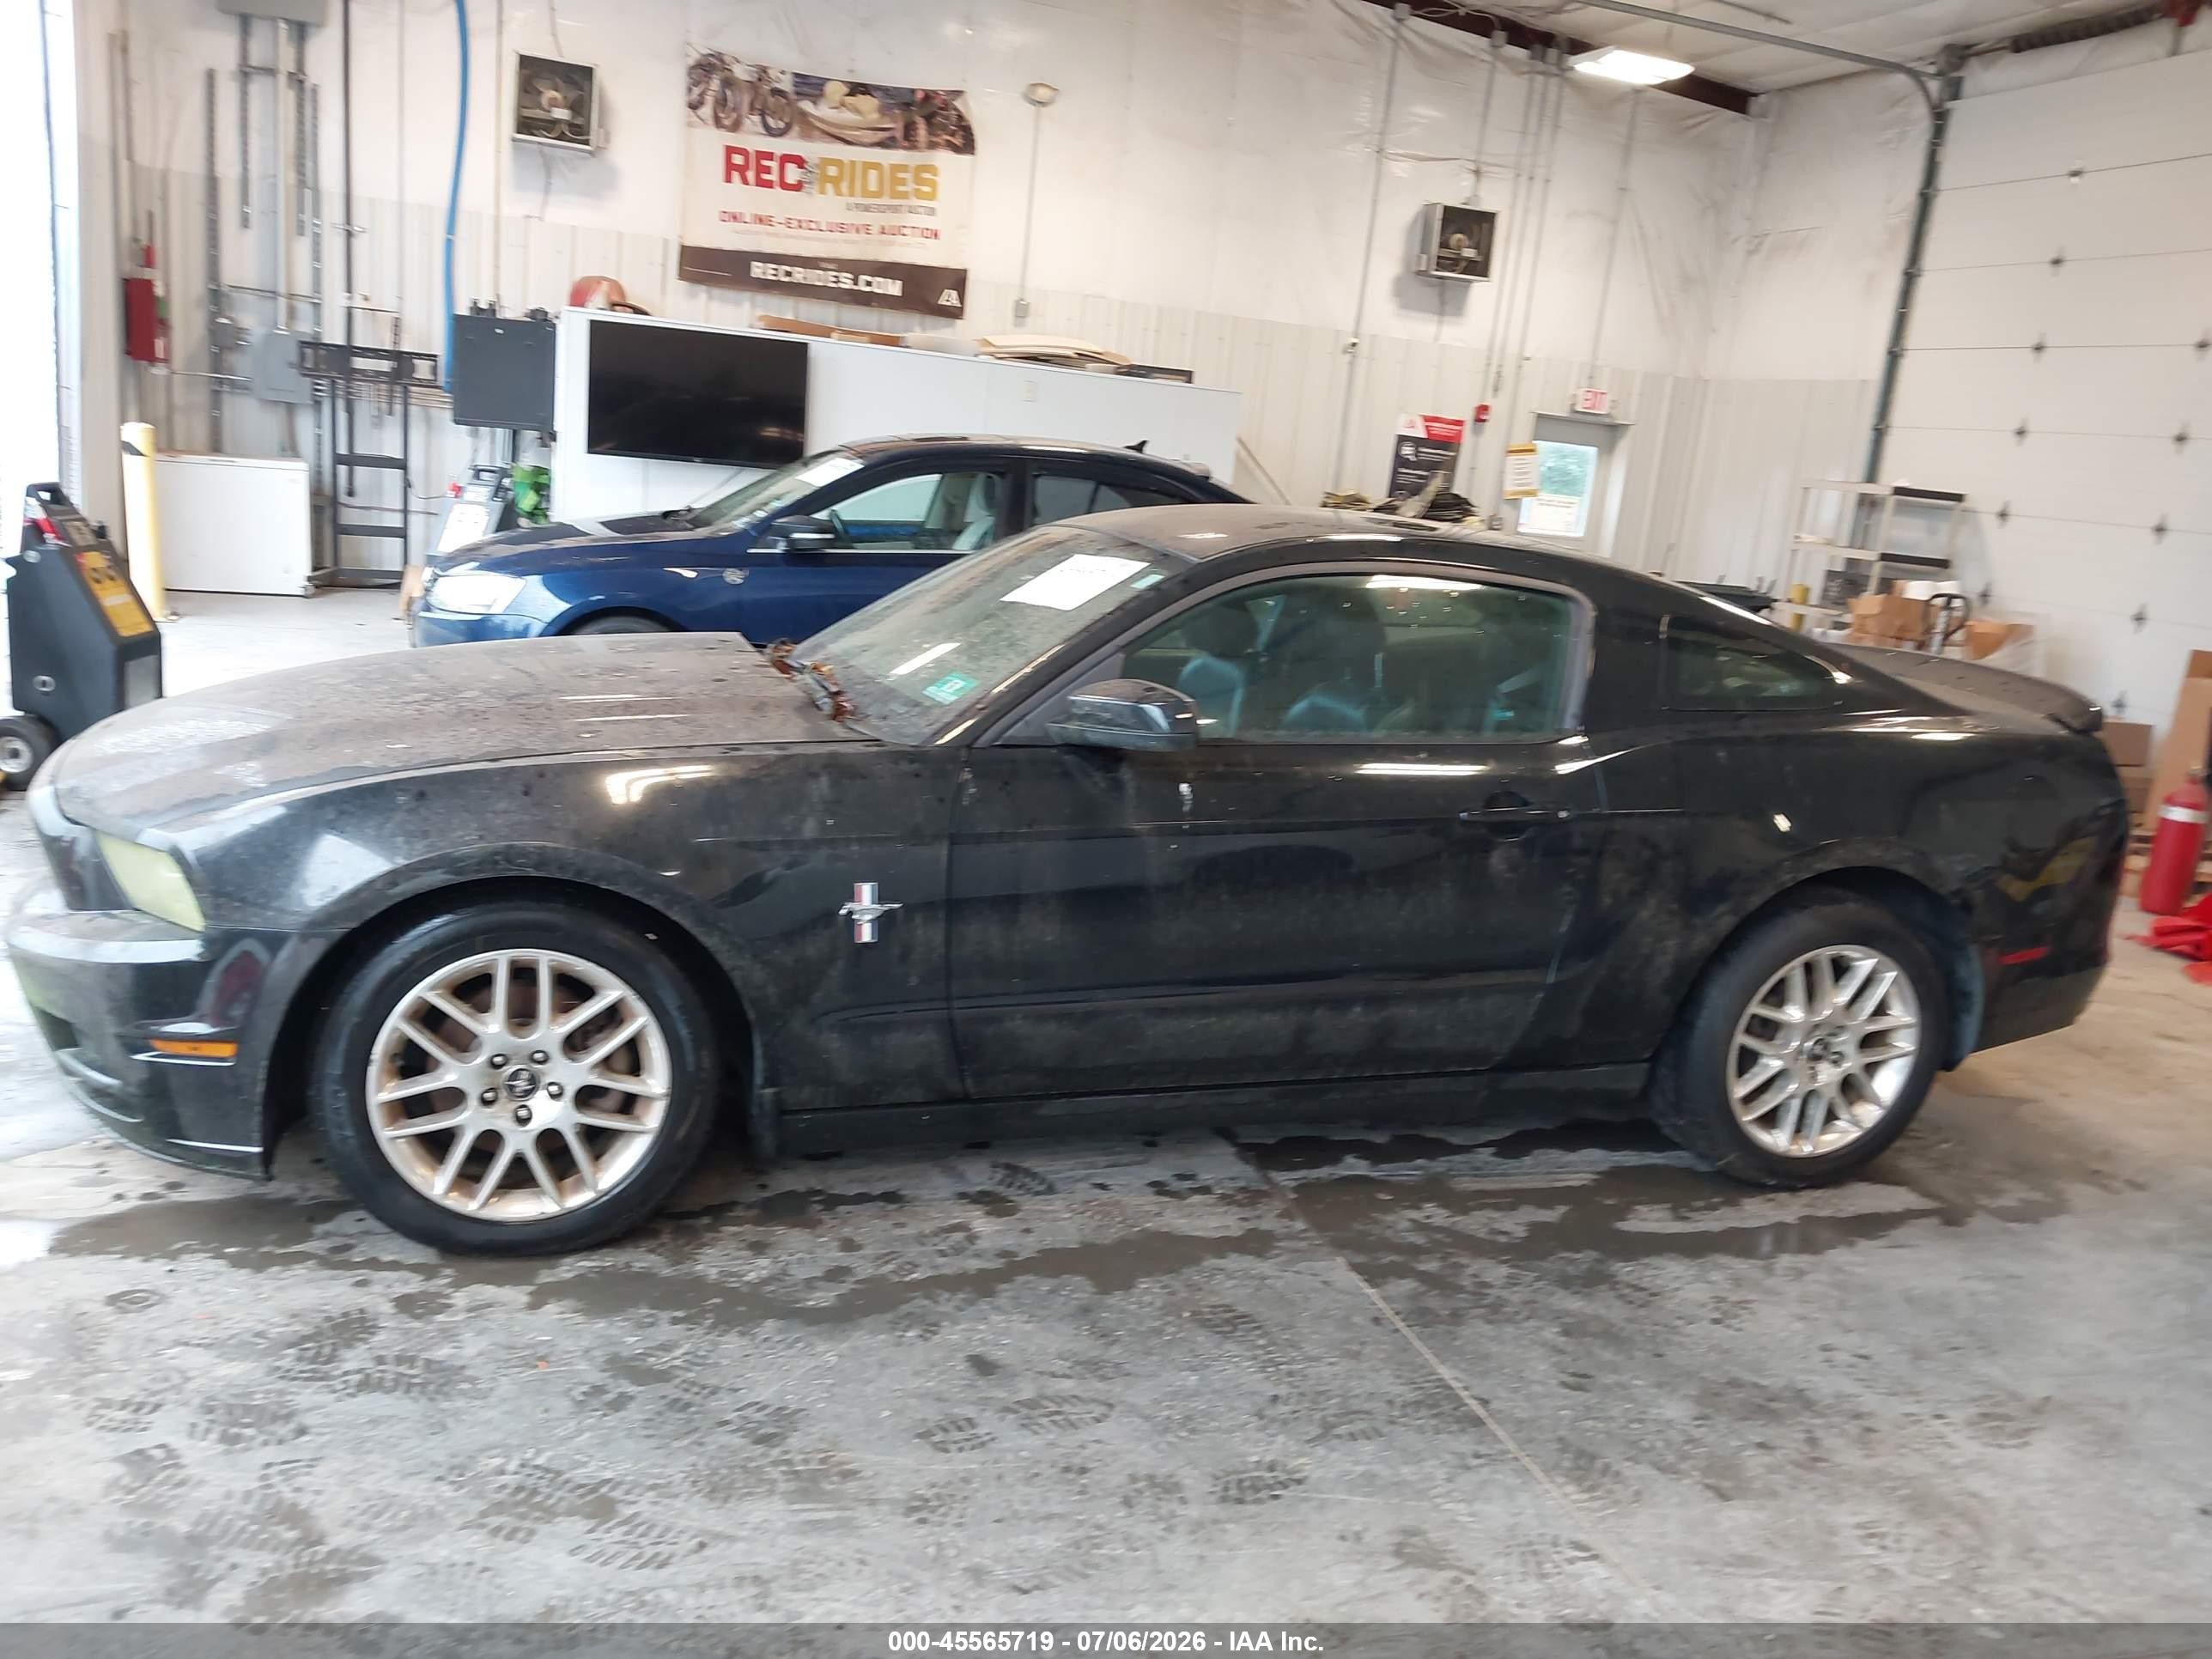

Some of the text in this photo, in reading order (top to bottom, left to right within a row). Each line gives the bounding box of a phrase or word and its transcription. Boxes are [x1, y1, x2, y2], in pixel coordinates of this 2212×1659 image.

[719, 210, 872, 235] ONLINE-EXCLUSIVE
[878, 224, 941, 240] AUCTION
[750, 261, 903, 297] RECRIDES.COM
[1582, 390, 1608, 410] EIT
